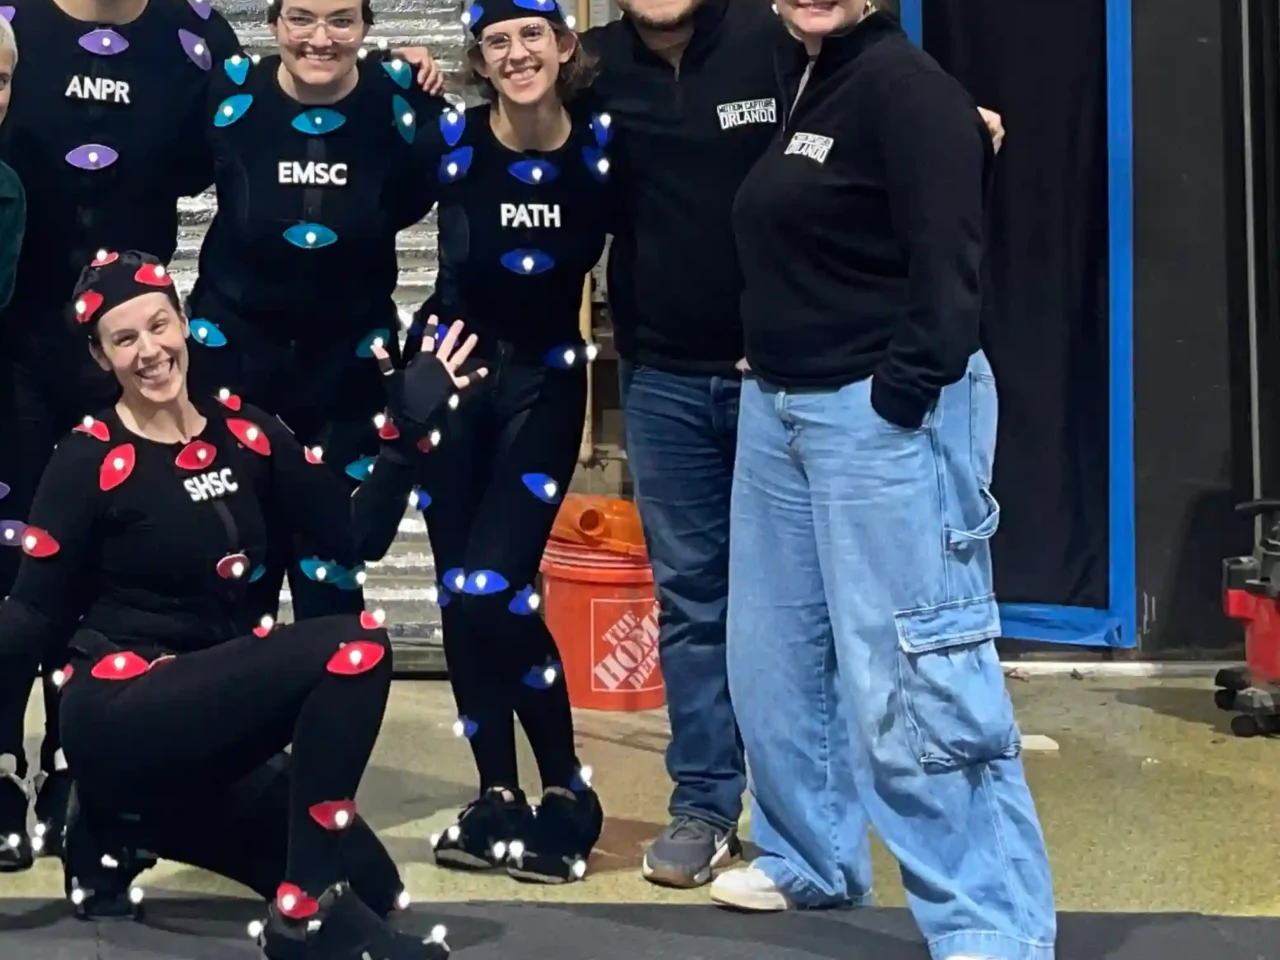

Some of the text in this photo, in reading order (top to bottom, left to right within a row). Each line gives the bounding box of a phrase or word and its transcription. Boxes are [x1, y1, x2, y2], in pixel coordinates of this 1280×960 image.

[64, 74, 131, 104] ANPR
[718, 108, 777, 130] ORLANDO
[278, 161, 348, 186] EMSC
[500, 203, 562, 228] PATH
[183, 467, 239, 502] SHSC
[601, 609, 640, 646] THE
[593, 600, 661, 690] HOM
